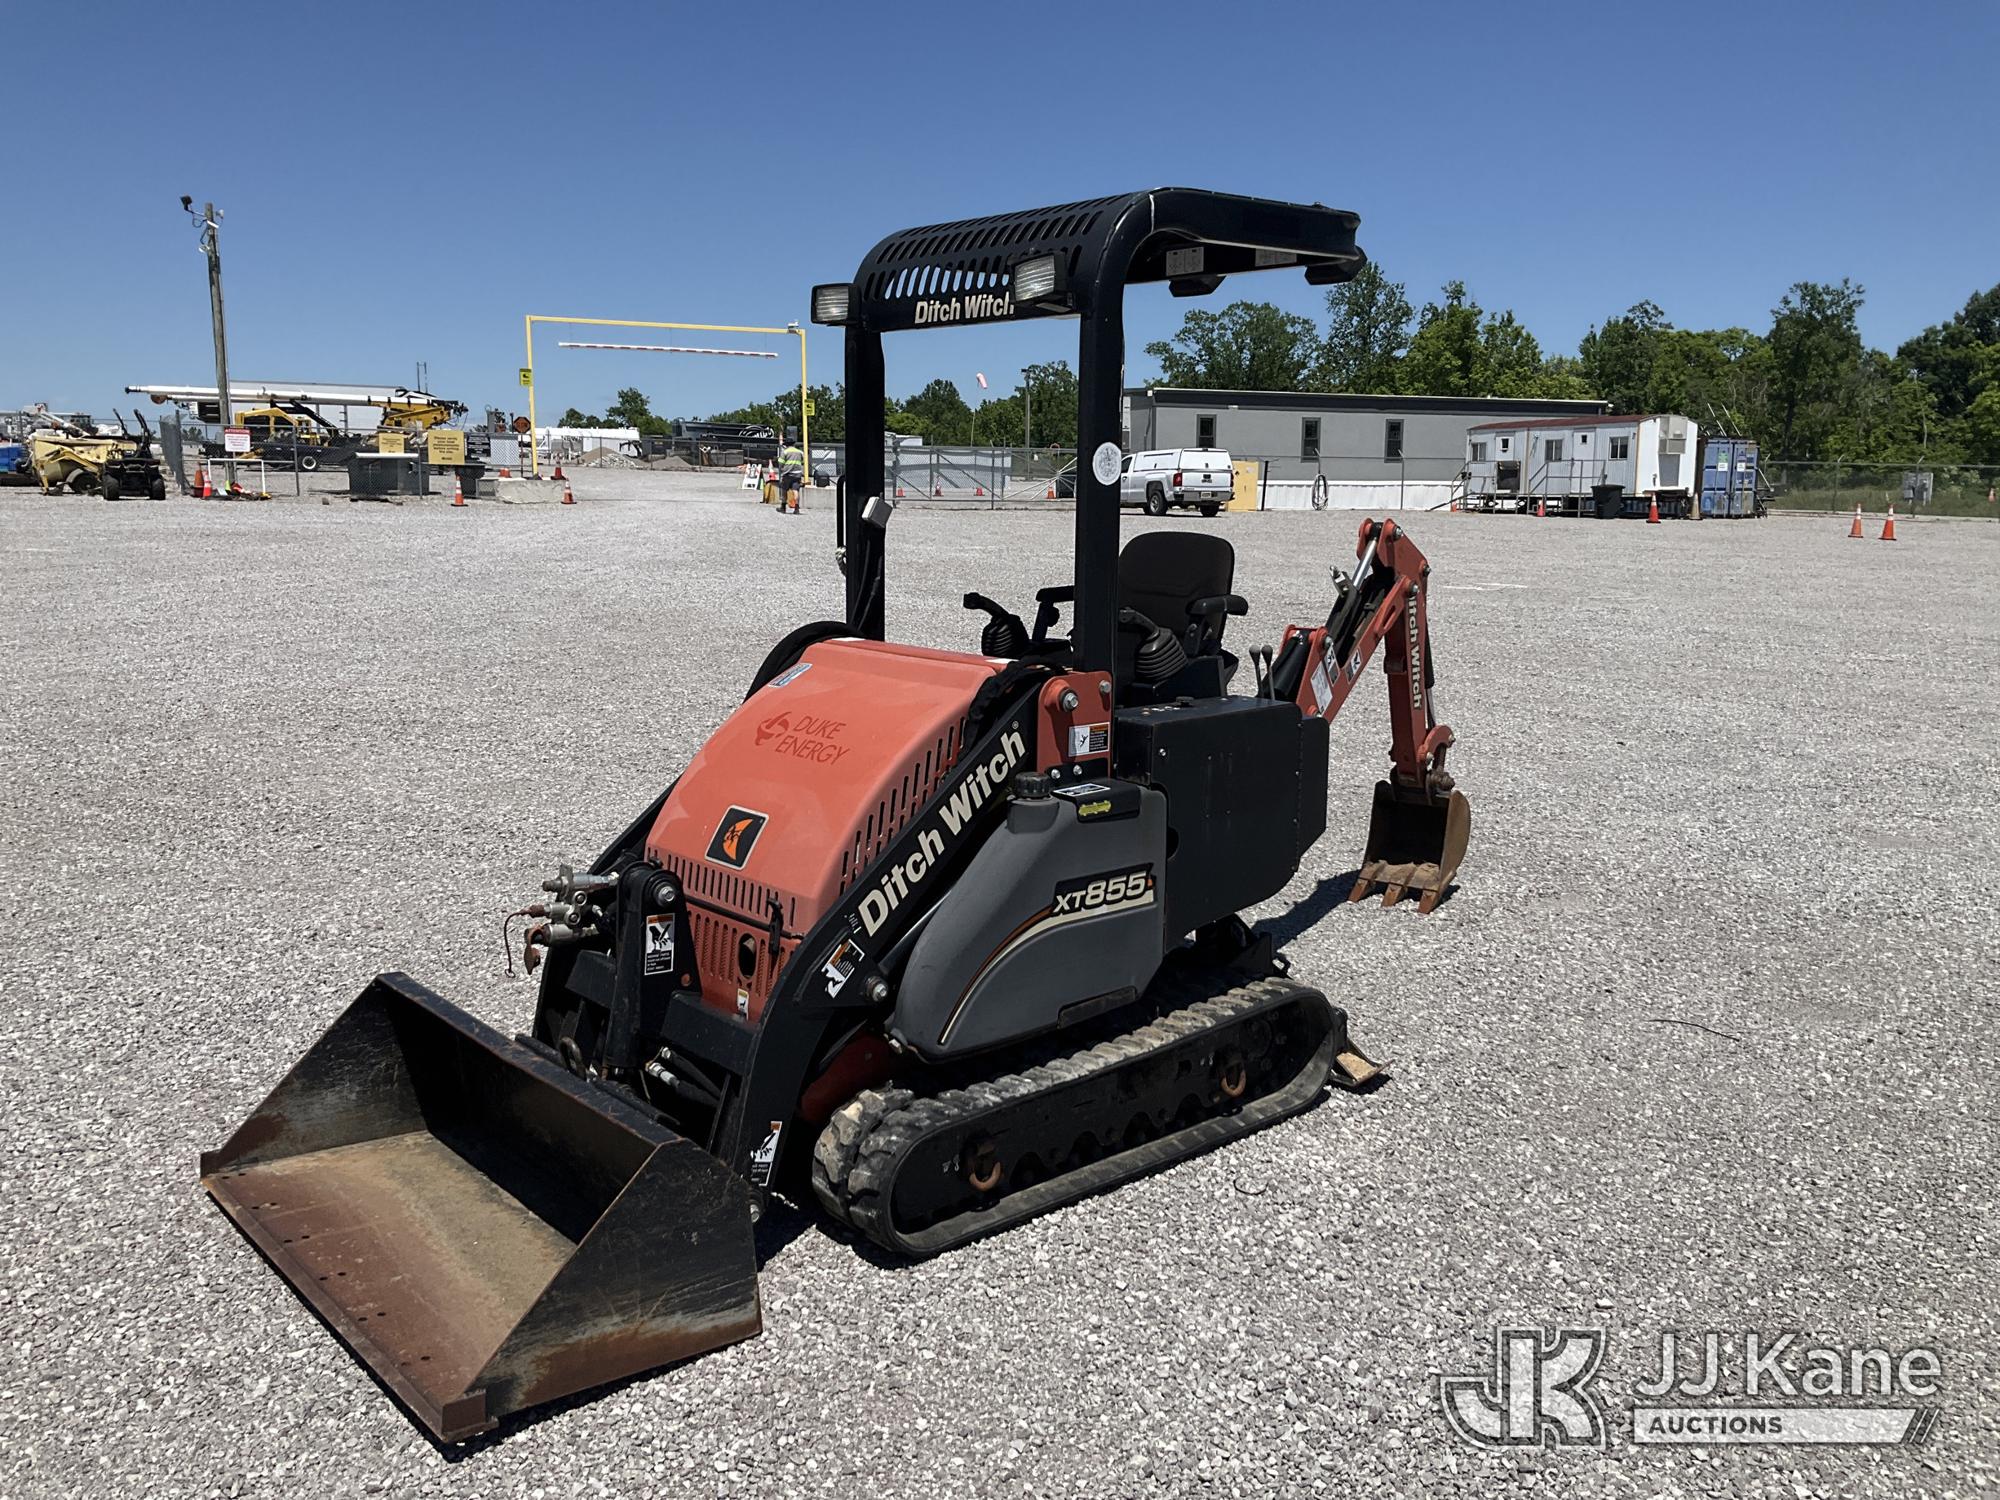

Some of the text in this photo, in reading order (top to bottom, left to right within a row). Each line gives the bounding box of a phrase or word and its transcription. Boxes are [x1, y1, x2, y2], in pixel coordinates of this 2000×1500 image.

[915, 297, 960, 324] Ditch
[1408, 594, 1422, 709] itch Witch
[793, 715, 847, 740] DUKE
[774, 735, 851, 766] ENERGY
[858, 731, 1026, 937] Ditch Witch
[1052, 871, 1147, 913] XT855
